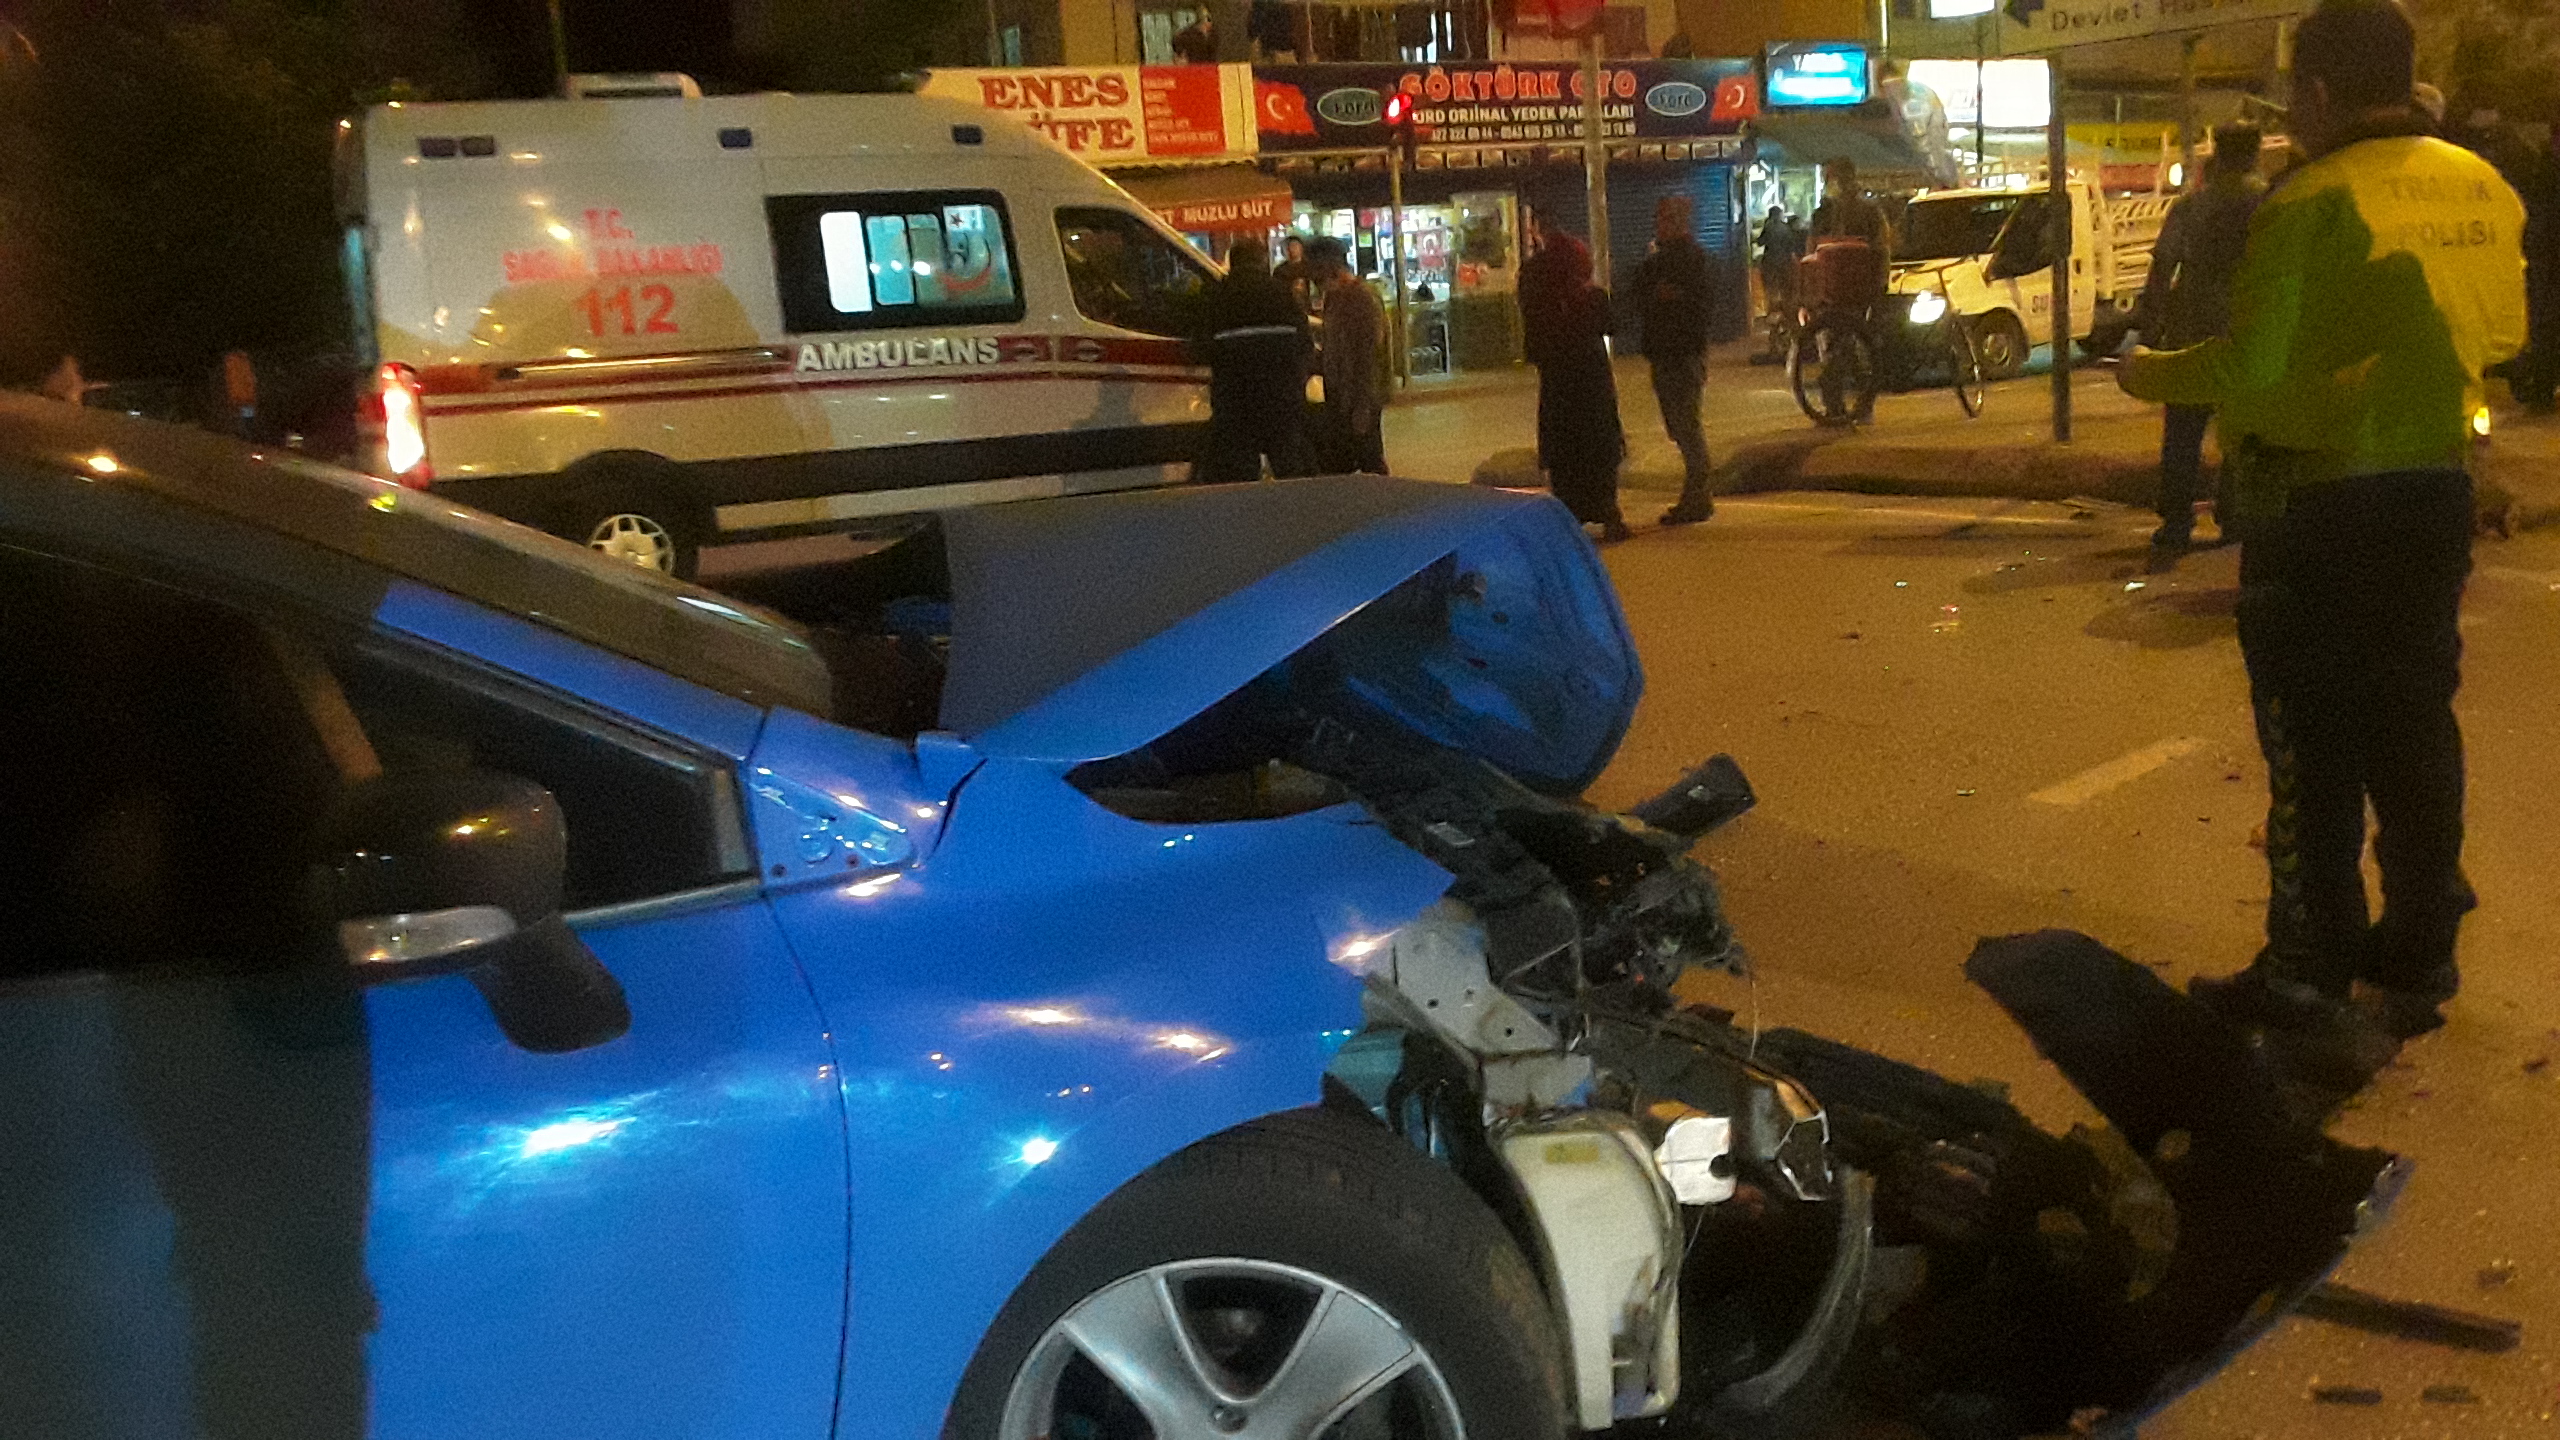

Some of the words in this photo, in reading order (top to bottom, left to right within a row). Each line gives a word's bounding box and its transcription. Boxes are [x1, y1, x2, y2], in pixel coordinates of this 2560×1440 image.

[2052, 2, 2142, 31] Devlet
[978, 72, 1129, 109] ENES
[1400, 64, 1562, 102] GÖKTÜRK
[1511, 105, 1556, 121] YEDEK
[574, 284, 679, 338] 112
[797, 335, 1000, 373] AMBULANS
